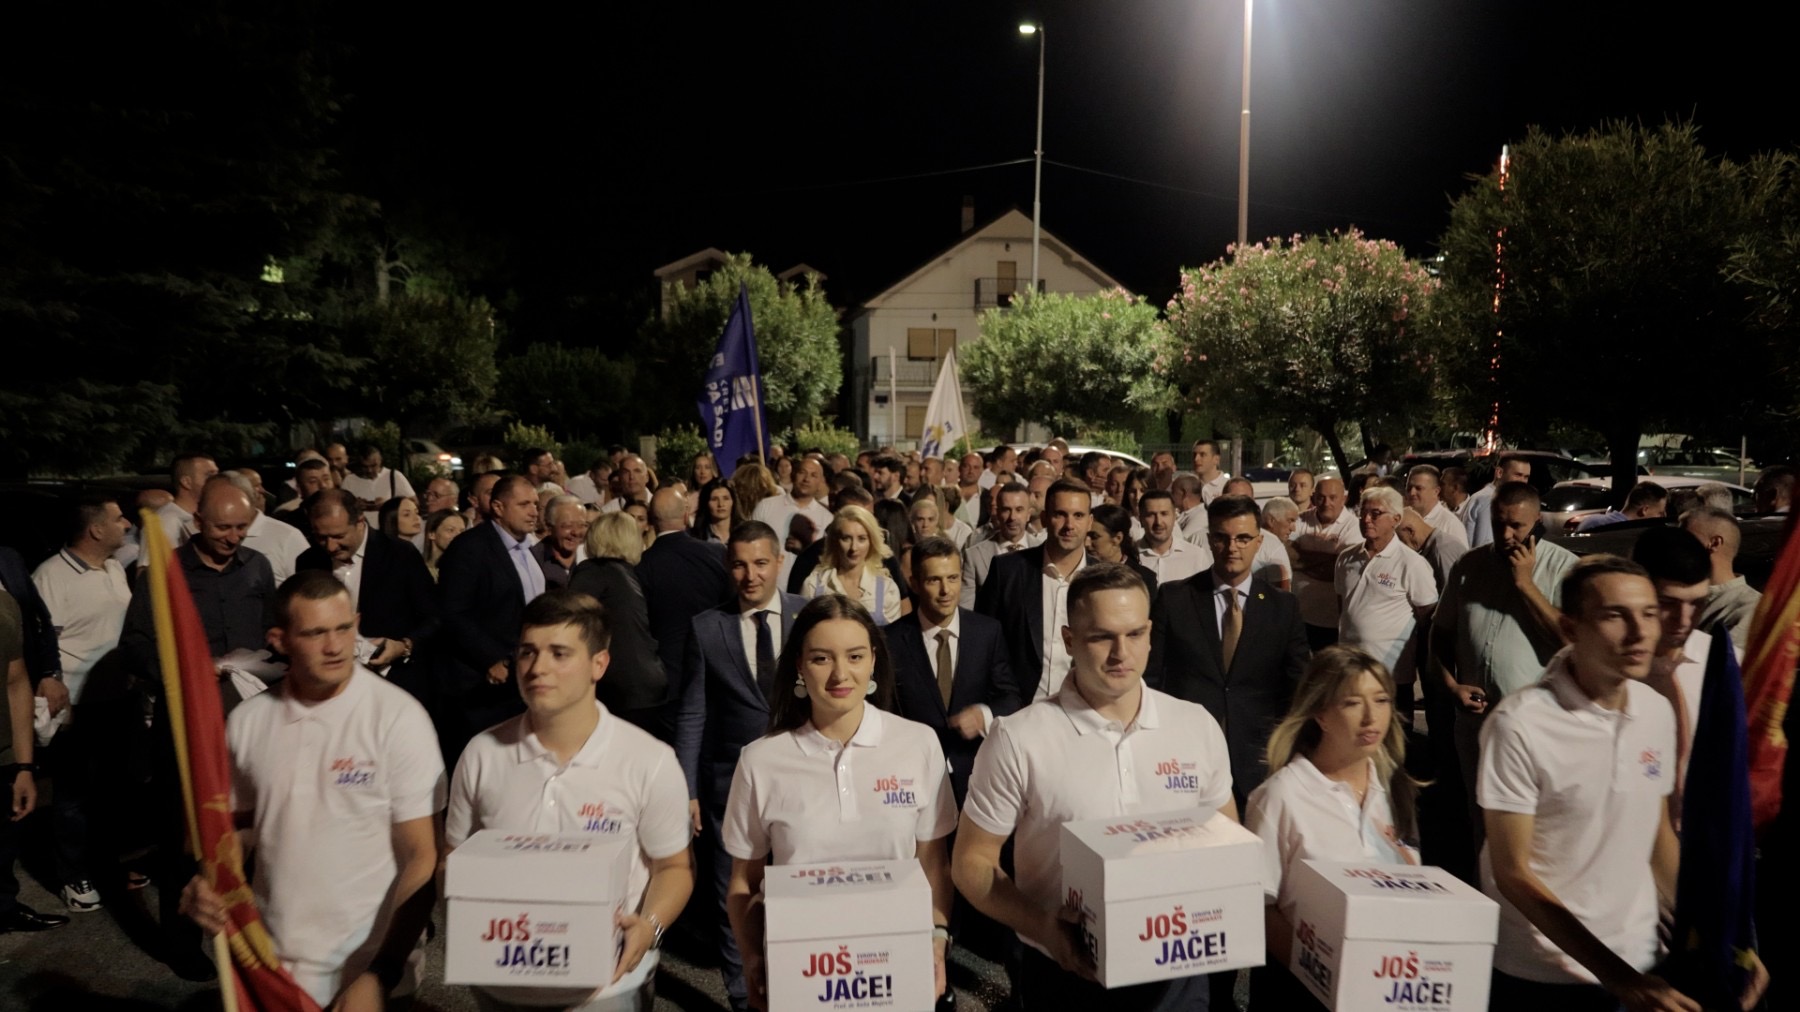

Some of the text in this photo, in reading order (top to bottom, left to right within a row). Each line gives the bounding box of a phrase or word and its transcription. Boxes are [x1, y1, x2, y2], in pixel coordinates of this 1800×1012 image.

[1155, 758, 1180, 776] JOŠ
[1165, 772, 1199, 790] JAČE!
[873, 775, 899, 792] JOŠ
[883, 788, 916, 805] JAČE!
[481, 912, 531, 942] JOŠ
[1138, 905, 1188, 942] JOŠ
[495, 938, 570, 968] JAČE!
[802, 945, 852, 978] JOŠ
[1155, 929, 1227, 966] JAČE!
[1373, 951, 1419, 979] JOŠ
[818, 970, 893, 1002] JAČE!
[1384, 976, 1452, 1004] JAČE!
